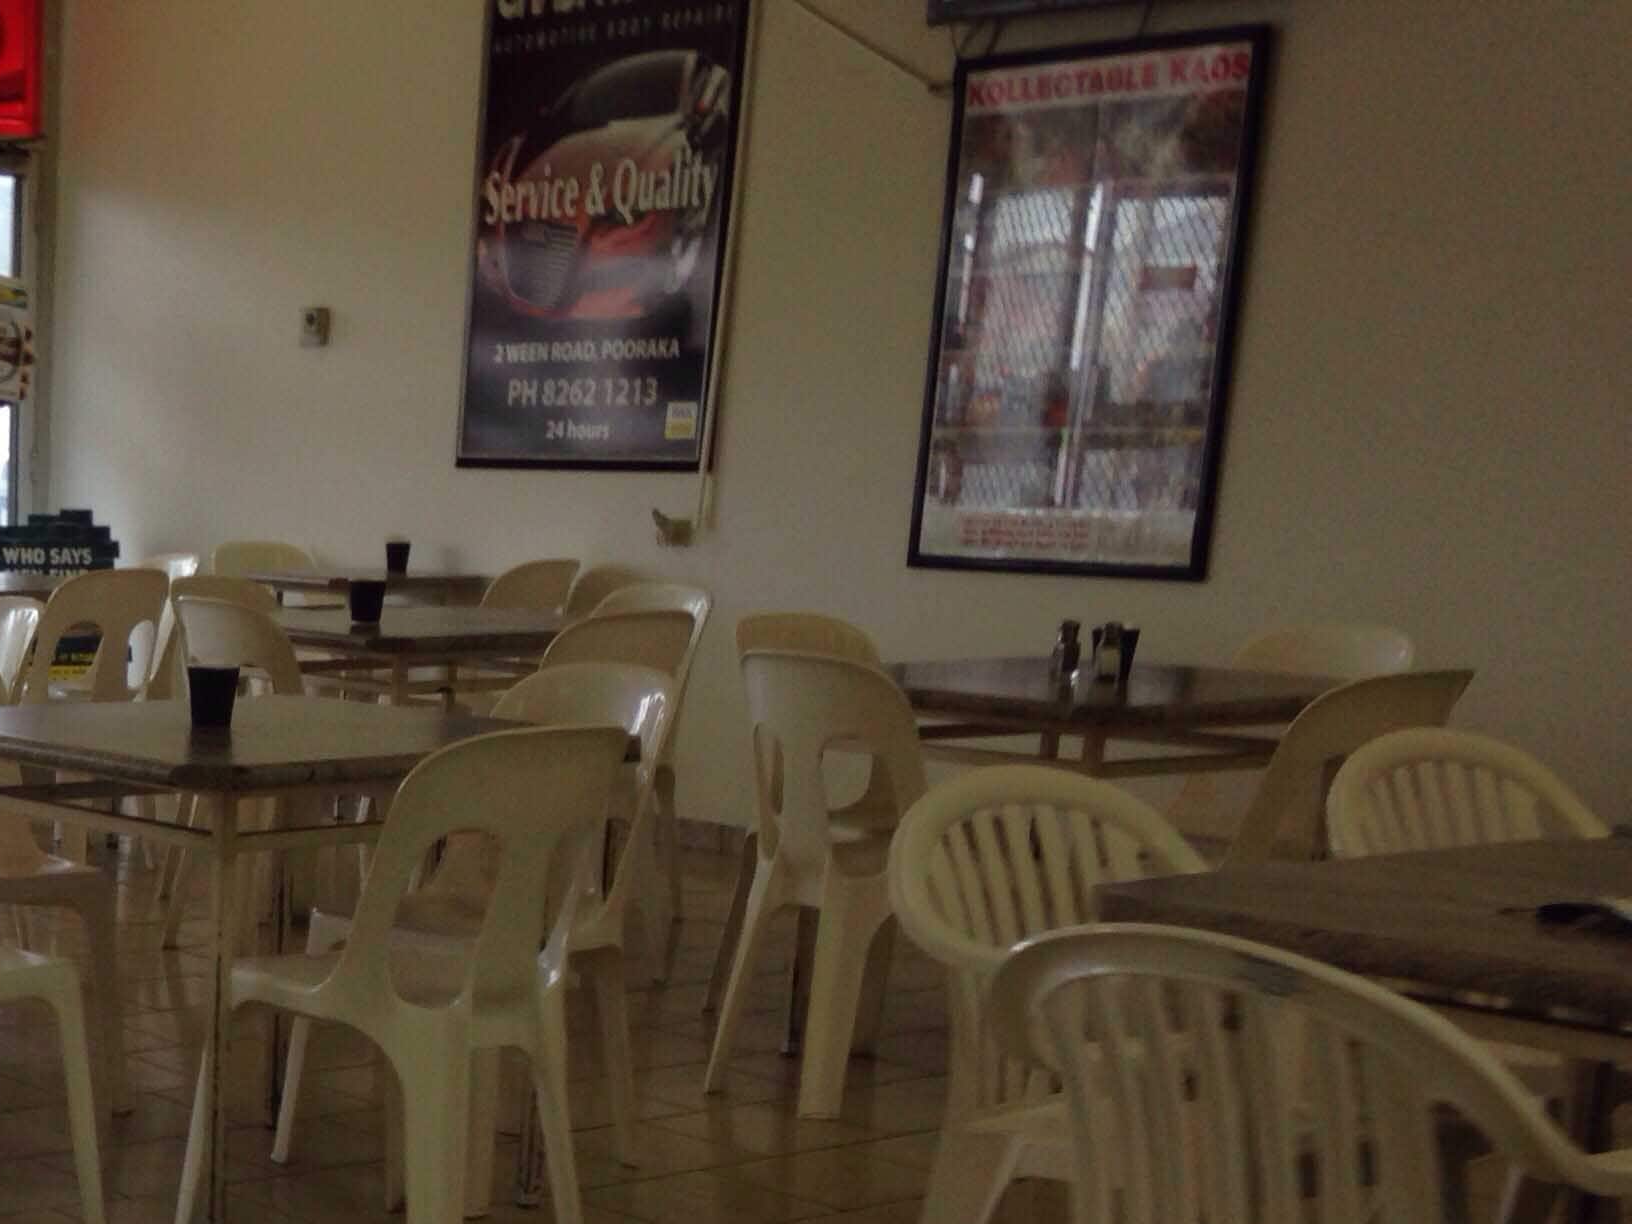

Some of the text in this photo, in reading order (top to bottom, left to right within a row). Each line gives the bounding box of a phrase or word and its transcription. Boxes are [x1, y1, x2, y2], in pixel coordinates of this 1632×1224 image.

[967, 49, 1251, 107] KOLLECTABLE KAOS
[485, 137, 718, 225] Service & Quality
[601, 338, 680, 360] POORAKA
[507, 377, 659, 407] PH 8262 1213
[545, 418, 610, 441] 24 hours
[1, 546, 93, 566] WHO SAYS
